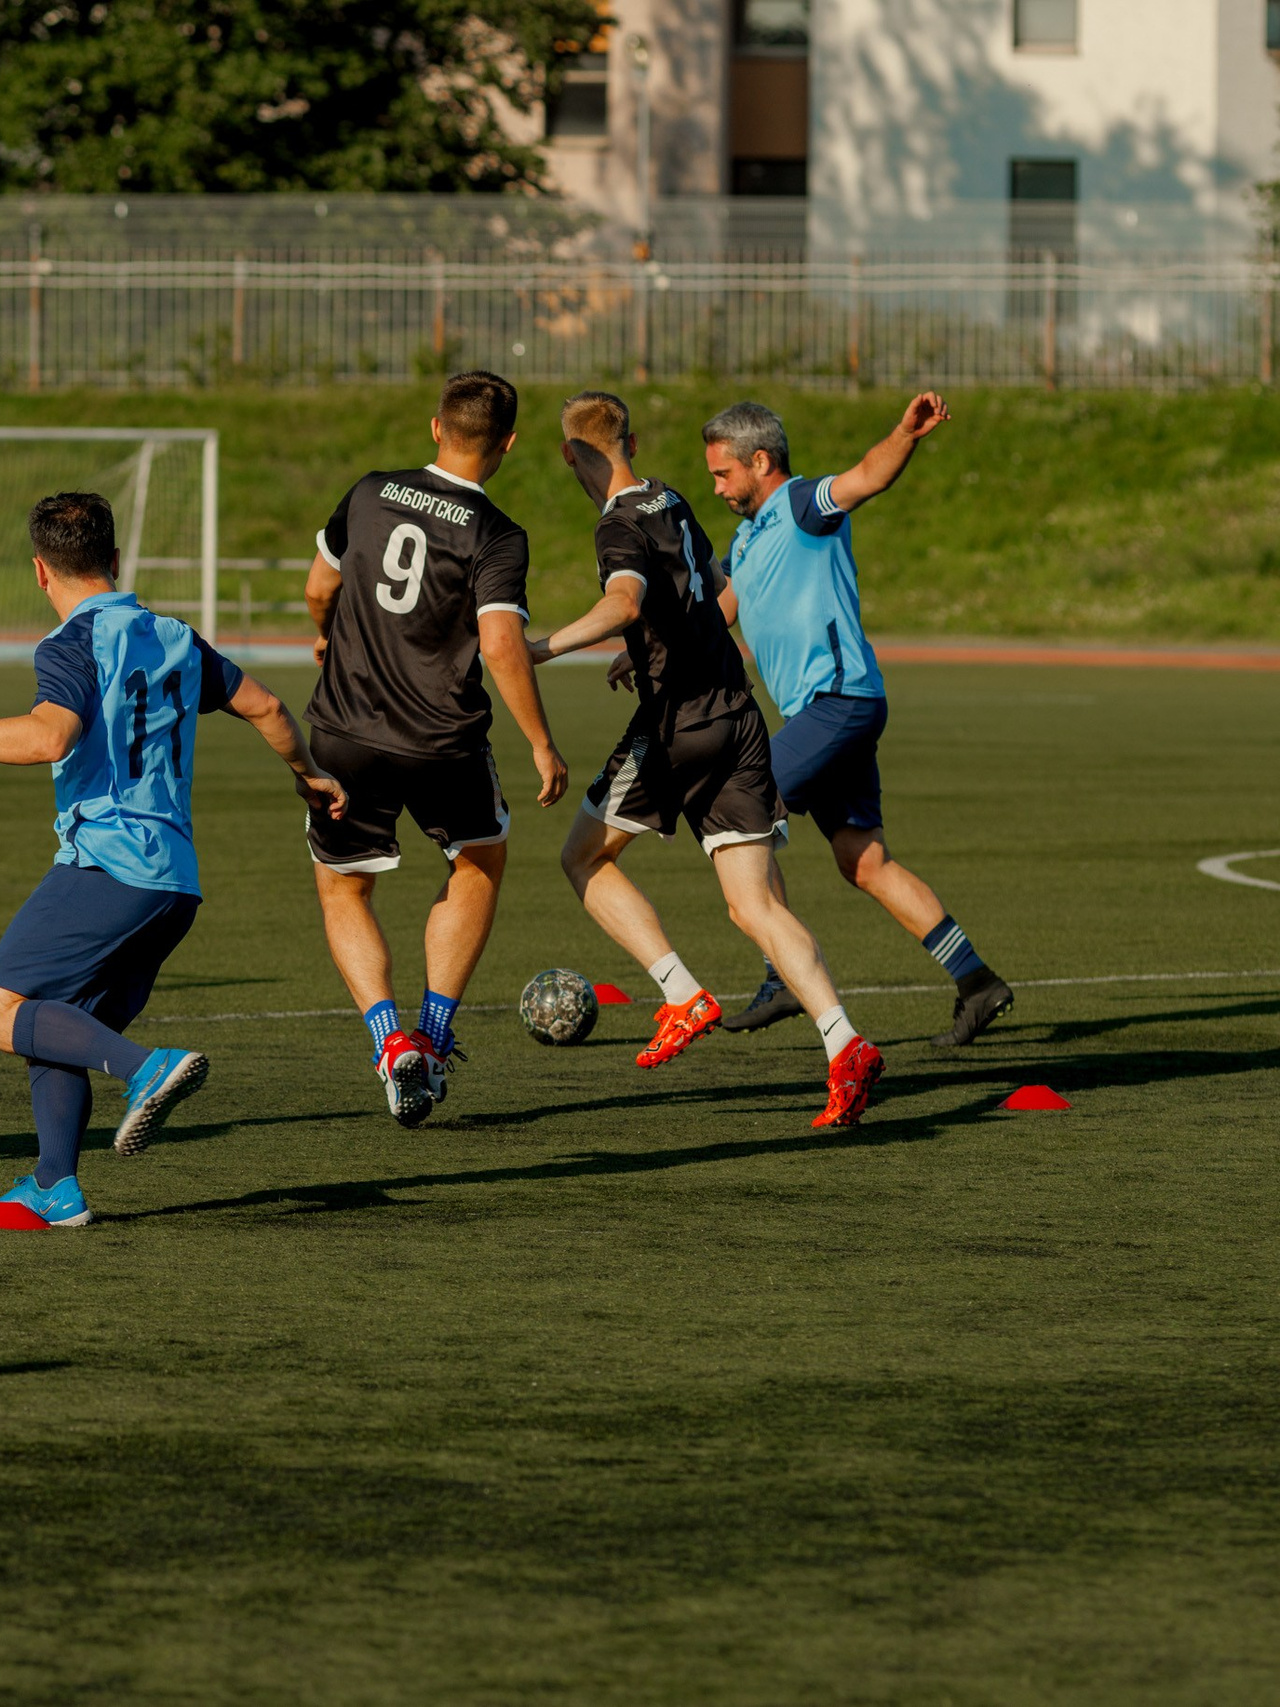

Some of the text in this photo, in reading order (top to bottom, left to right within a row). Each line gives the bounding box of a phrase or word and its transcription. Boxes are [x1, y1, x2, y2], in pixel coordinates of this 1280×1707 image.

[380, 482, 474, 526] ВЫБОРГСКОЕ
[376, 523, 427, 614] 9
[124, 669, 187, 779] 11
